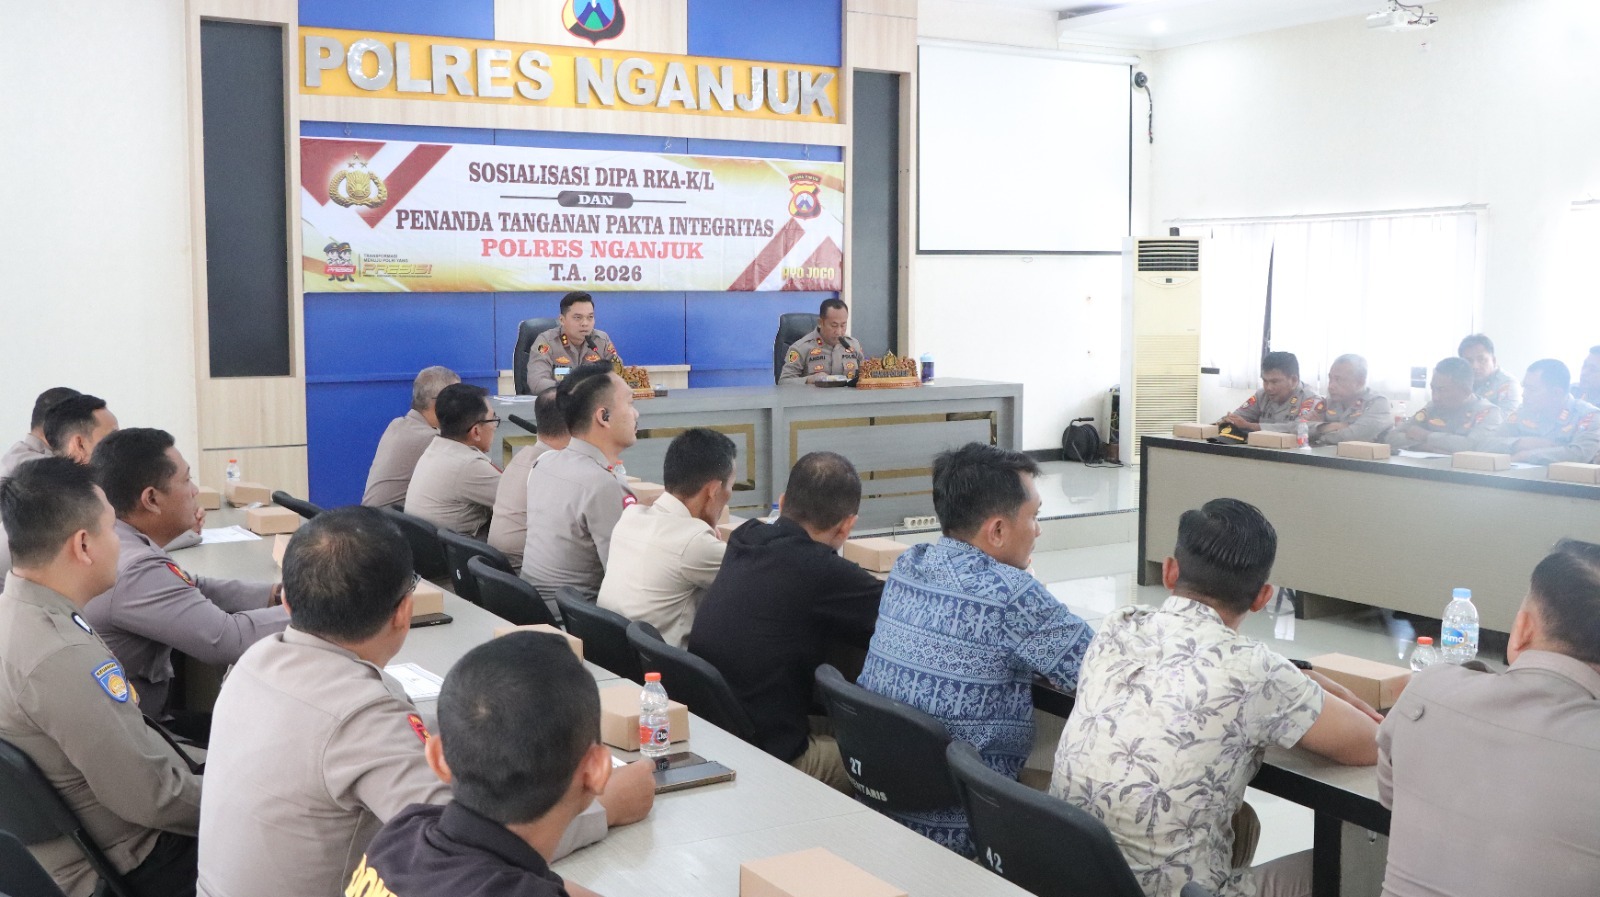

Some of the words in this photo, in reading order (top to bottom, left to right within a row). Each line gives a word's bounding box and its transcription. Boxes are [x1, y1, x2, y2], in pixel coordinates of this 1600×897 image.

[304, 35, 554, 100] POLRES
[574, 56, 836, 117] NGANJUK
[468, 161, 590, 186] SOSIALISASI
[594, 166, 639, 188] DIPA
[642, 168, 715, 192] RKA-K/L
[577, 194, 614, 206] DAN
[395, 209, 494, 232] PENANDA
[498, 212, 601, 233] TANGANAN
[605, 214, 665, 236] PAKTA
[668, 216, 775, 238] INTEGRITAS
[480, 238, 583, 258] POLRES
[589, 240, 704, 260] NGANJUK
[362, 263, 433, 275] PRESISI
[549, 263, 587, 282] T.A.
[594, 264, 642, 282] 2026
[781, 266, 804, 281] AYO
[849, 756, 862, 777] 27
[986, 846, 1003, 874] 42
